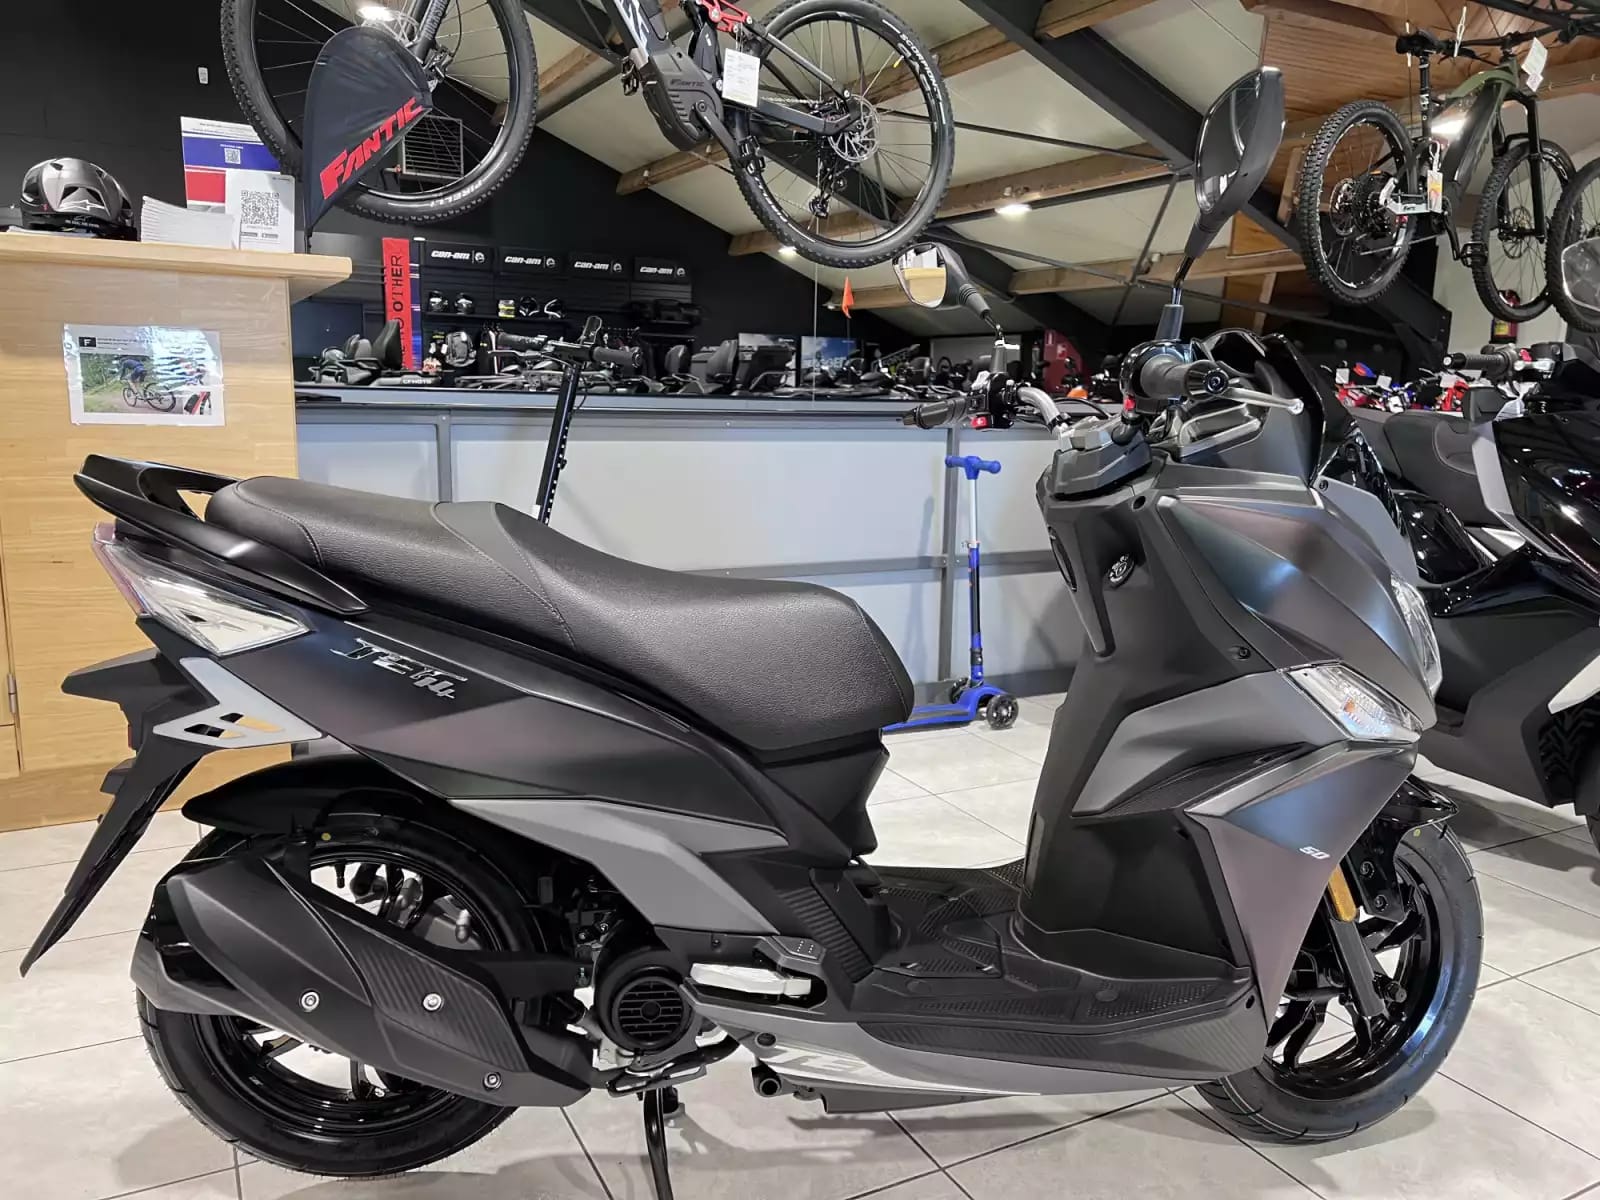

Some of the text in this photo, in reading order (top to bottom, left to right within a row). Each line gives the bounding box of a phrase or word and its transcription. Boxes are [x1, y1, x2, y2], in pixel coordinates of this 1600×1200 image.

[319, 96, 424, 200] FANTIC
[431, 250, 470, 260] can-am
[505, 256, 542, 265] can-am
[574, 261, 610, 270] can-am
[391, 255, 404, 313] OTHER
[1299, 846, 1331, 860] 50
